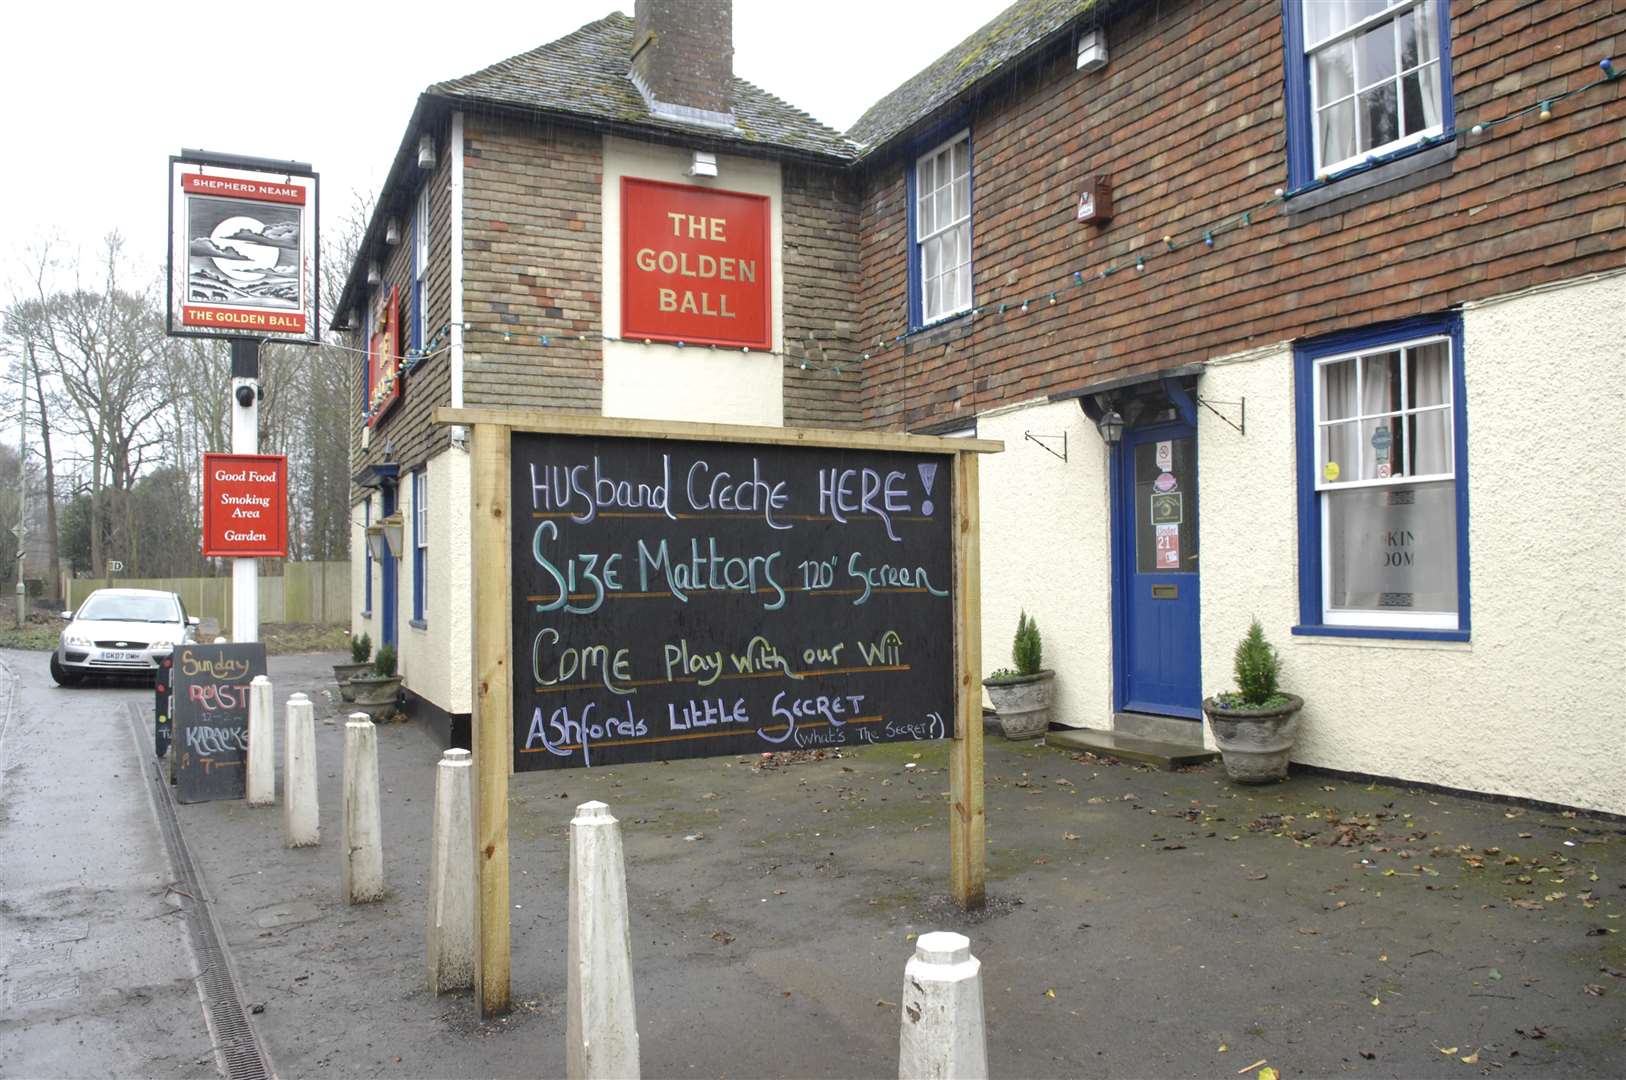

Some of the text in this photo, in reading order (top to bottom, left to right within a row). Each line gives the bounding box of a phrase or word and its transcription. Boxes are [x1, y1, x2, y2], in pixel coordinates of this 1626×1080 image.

[193, 178, 298, 197] SHEPHERD NEAME
[668, 212, 727, 242] THE
[636, 248, 756, 283] GOLDEN
[659, 288, 736, 318] BALL
[188, 310, 300, 327] THE GOLDEN BALL
[215, 470, 276, 482] Good Food
[220, 493, 271, 507] Smoking
[231, 507, 260, 518] Area
[224, 529, 267, 542] Garden
[637, 537, 786, 610] Matters
[848, 551, 949, 605] Screen
[182, 650, 249, 680] Sunday
[664, 639, 723, 686] Play
[803, 642, 845, 665] our
[857, 630, 903, 666] Wii
[856, 727, 880, 744] The
